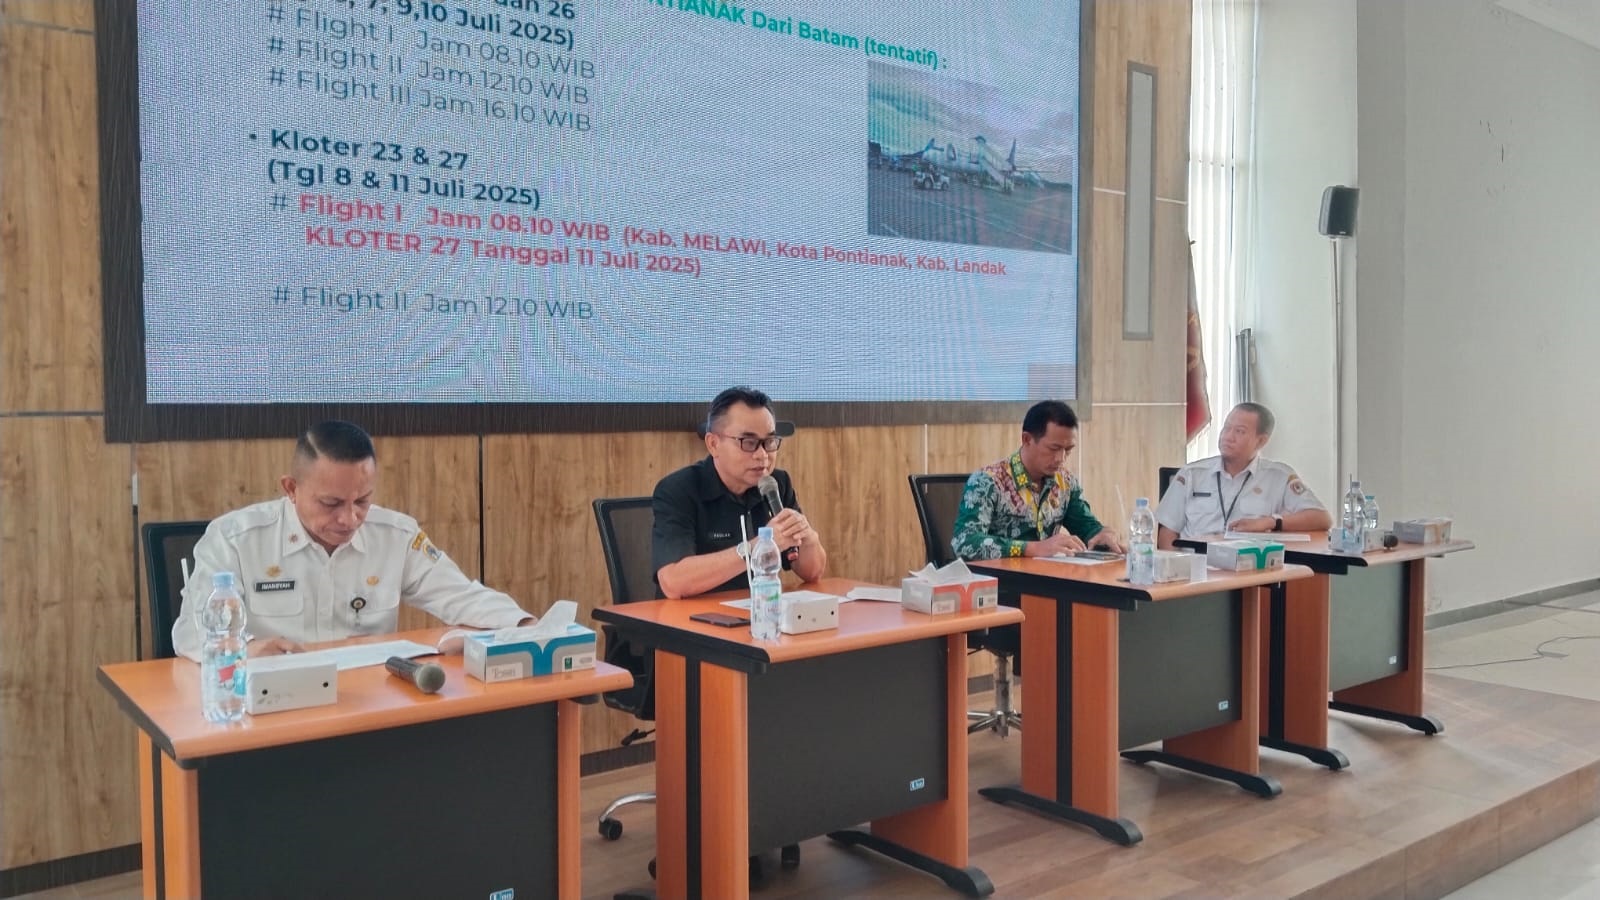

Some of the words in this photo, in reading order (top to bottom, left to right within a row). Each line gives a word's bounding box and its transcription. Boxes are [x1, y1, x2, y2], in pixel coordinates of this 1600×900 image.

[455, 7, 501, 34] Juli
[509, 19, 574, 50] 2025)
[549, 0, 575, 19] 26
[296, 8, 379, 41] Flight
[416, 29, 471, 58] Jam
[480, 41, 540, 69] 08.10
[546, 55, 596, 79] WIB
[752, 11, 792, 35] Dari
[799, 20, 859, 50] Batam
[864, 36, 939, 70] (tentatif)
[296, 39, 379, 72] Flight
[418, 60, 473, 86] Jam
[482, 69, 534, 96] 12.10
[541, 81, 588, 105] WIB
[297, 69, 378, 100] Flight
[419, 88, 474, 115] Jam
[483, 97, 536, 123] 16.10
[543, 108, 591, 131] WIB
[271, 129, 362, 158] Kloter
[372, 142, 402, 163] 23
[412, 146, 430, 165] &
[438, 150, 469, 170] 27
[268, 158, 324, 187] (Tgl
[334, 167, 351, 186] 8
[362, 169, 380, 189] &
[389, 173, 409, 192] 11
[418, 177, 465, 199] Juli
[473, 182, 540, 211] 2025)
[300, 193, 385, 222] Flight
[426, 207, 481, 230] Jam
[489, 213, 554, 235] 08.10
[561, 220, 610, 242] WIB
[623, 225, 677, 248] (Kab.
[683, 232, 772, 257] MELAWI,
[777, 241, 818, 261] Kota
[823, 245, 913, 270] Pontianak,
[916, 255, 950, 271] Kab.
[954, 257, 1007, 275] Landak
[306, 226, 421, 253] KLOTER
[430, 236, 461, 256] 27
[471, 238, 570, 266] Tanggal
[575, 249, 594, 266] 11
[600, 249, 638, 269] Juli
[645, 253, 701, 278] 2025)
[303, 286, 384, 313] Flight
[422, 293, 478, 314] Jam
[485, 296, 538, 317] 12.10
[545, 300, 593, 320] WIB
